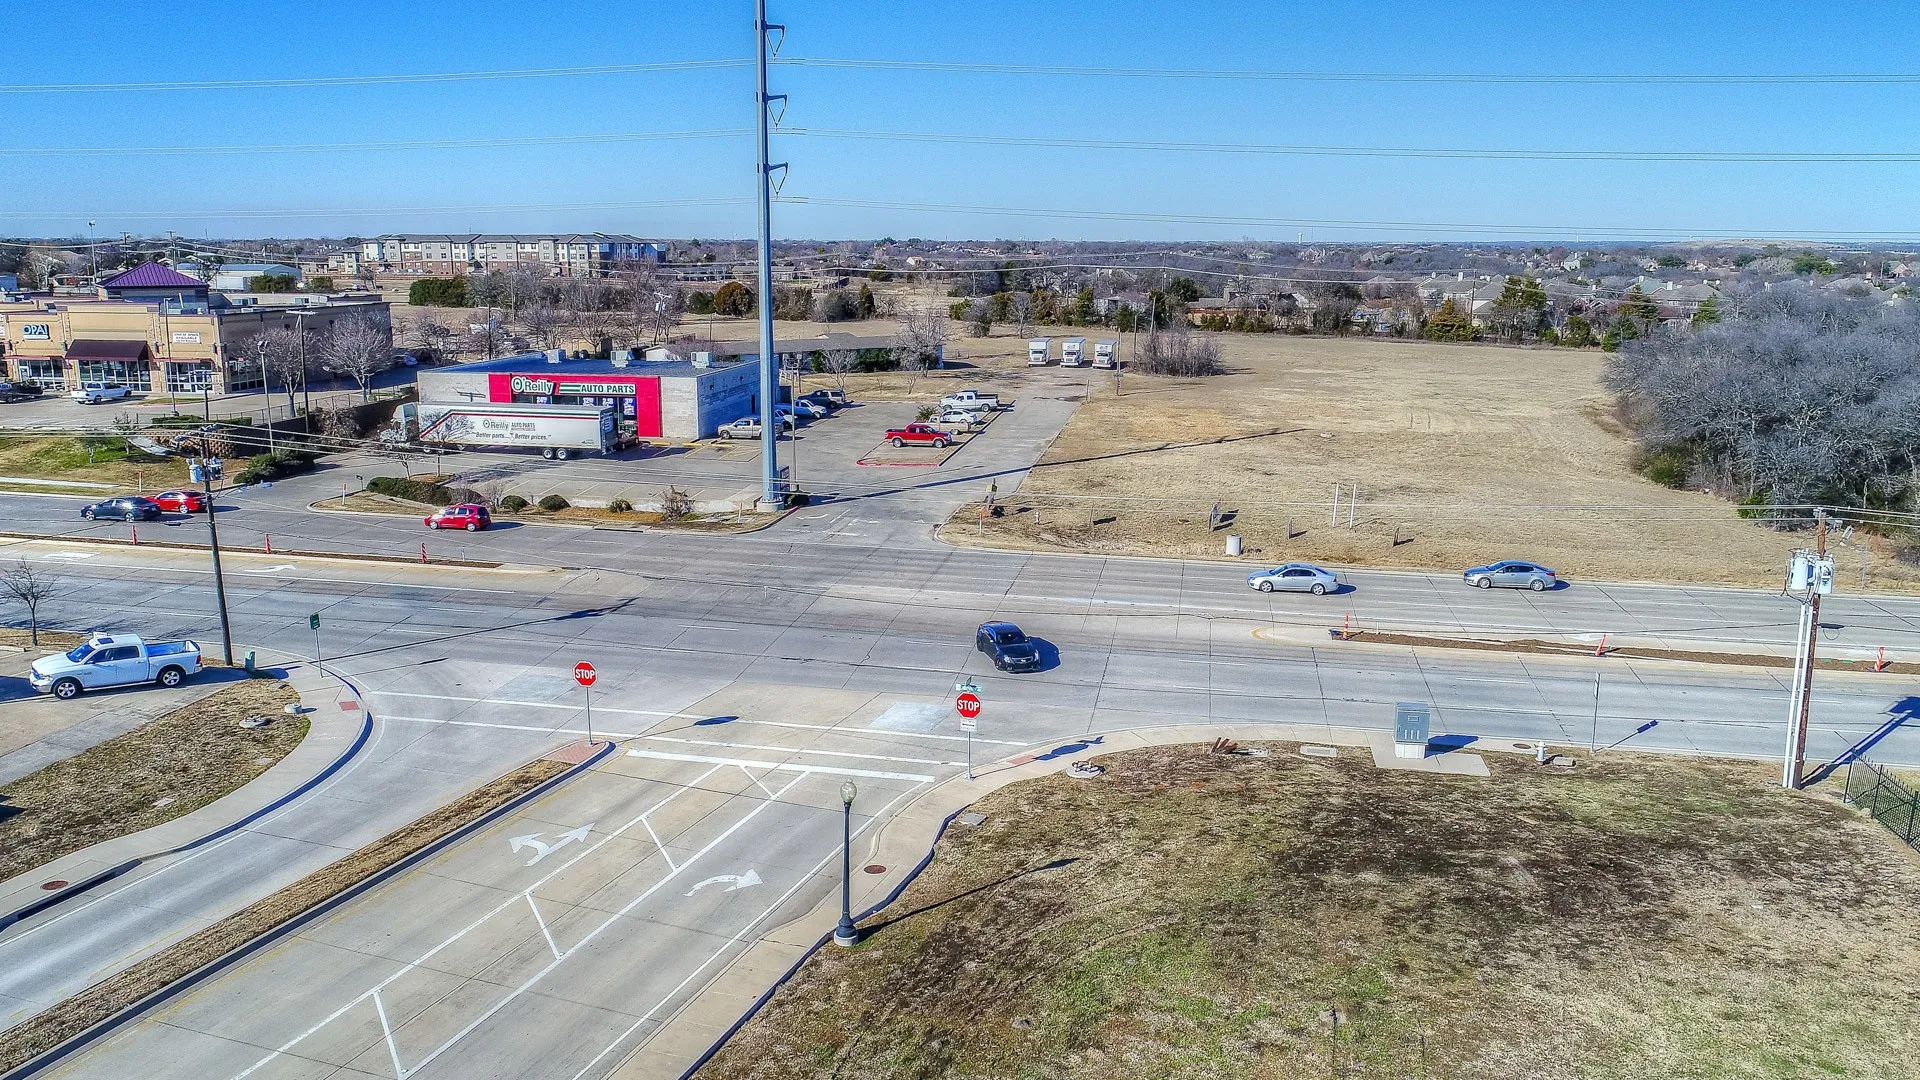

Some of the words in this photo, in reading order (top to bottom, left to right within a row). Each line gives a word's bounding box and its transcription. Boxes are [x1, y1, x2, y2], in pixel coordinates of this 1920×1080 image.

[23, 325, 48, 334] OPA!
[512, 377, 552, 394] O'Reilly
[581, 384, 604, 393] AUTO
[606, 385, 635, 393] PARTS
[483, 418, 509, 430] O'Reilly
[576, 669, 594, 679] STOP
[958, 700, 980, 712] STOP
